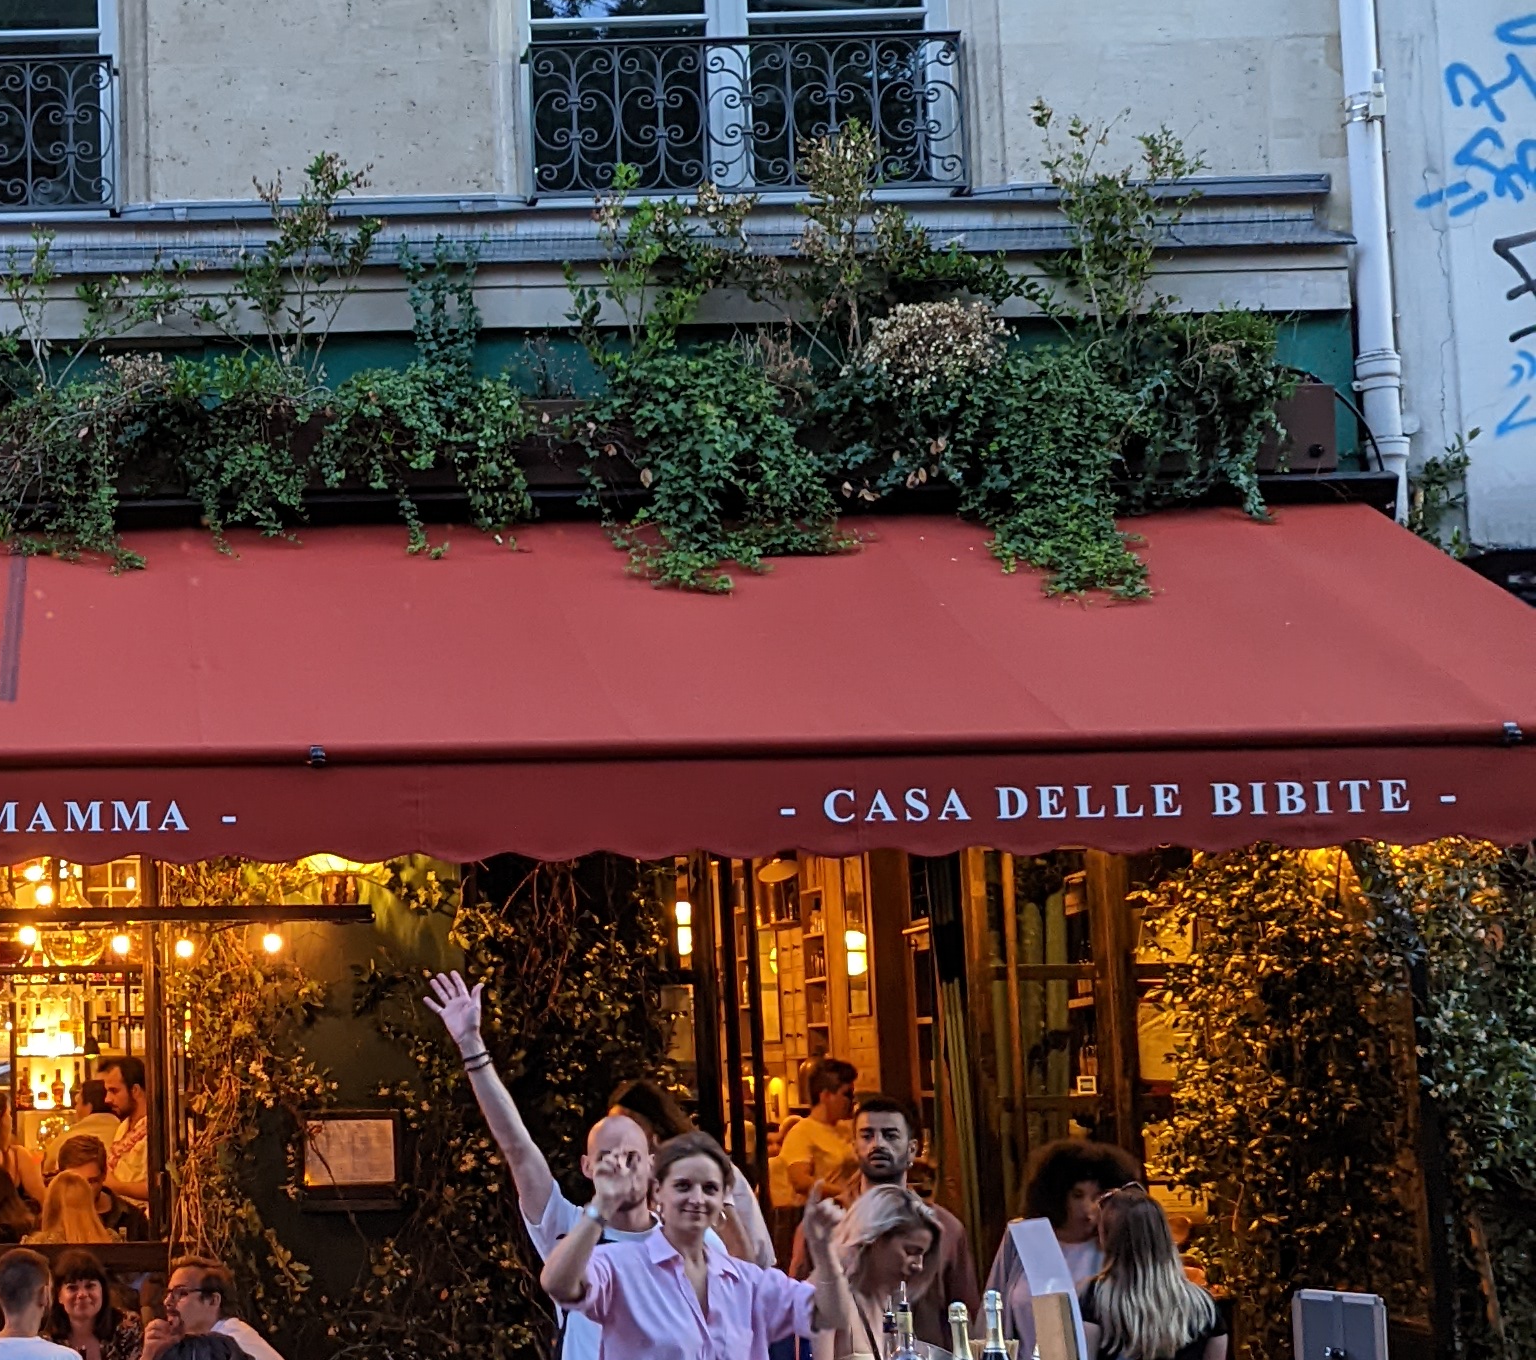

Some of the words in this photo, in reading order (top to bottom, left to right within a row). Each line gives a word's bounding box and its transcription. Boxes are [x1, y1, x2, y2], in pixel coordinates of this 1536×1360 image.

[823, 788, 972, 823] CASA
[995, 784, 1182, 820] DELLE
[1210, 779, 1410, 816] BIBITE
